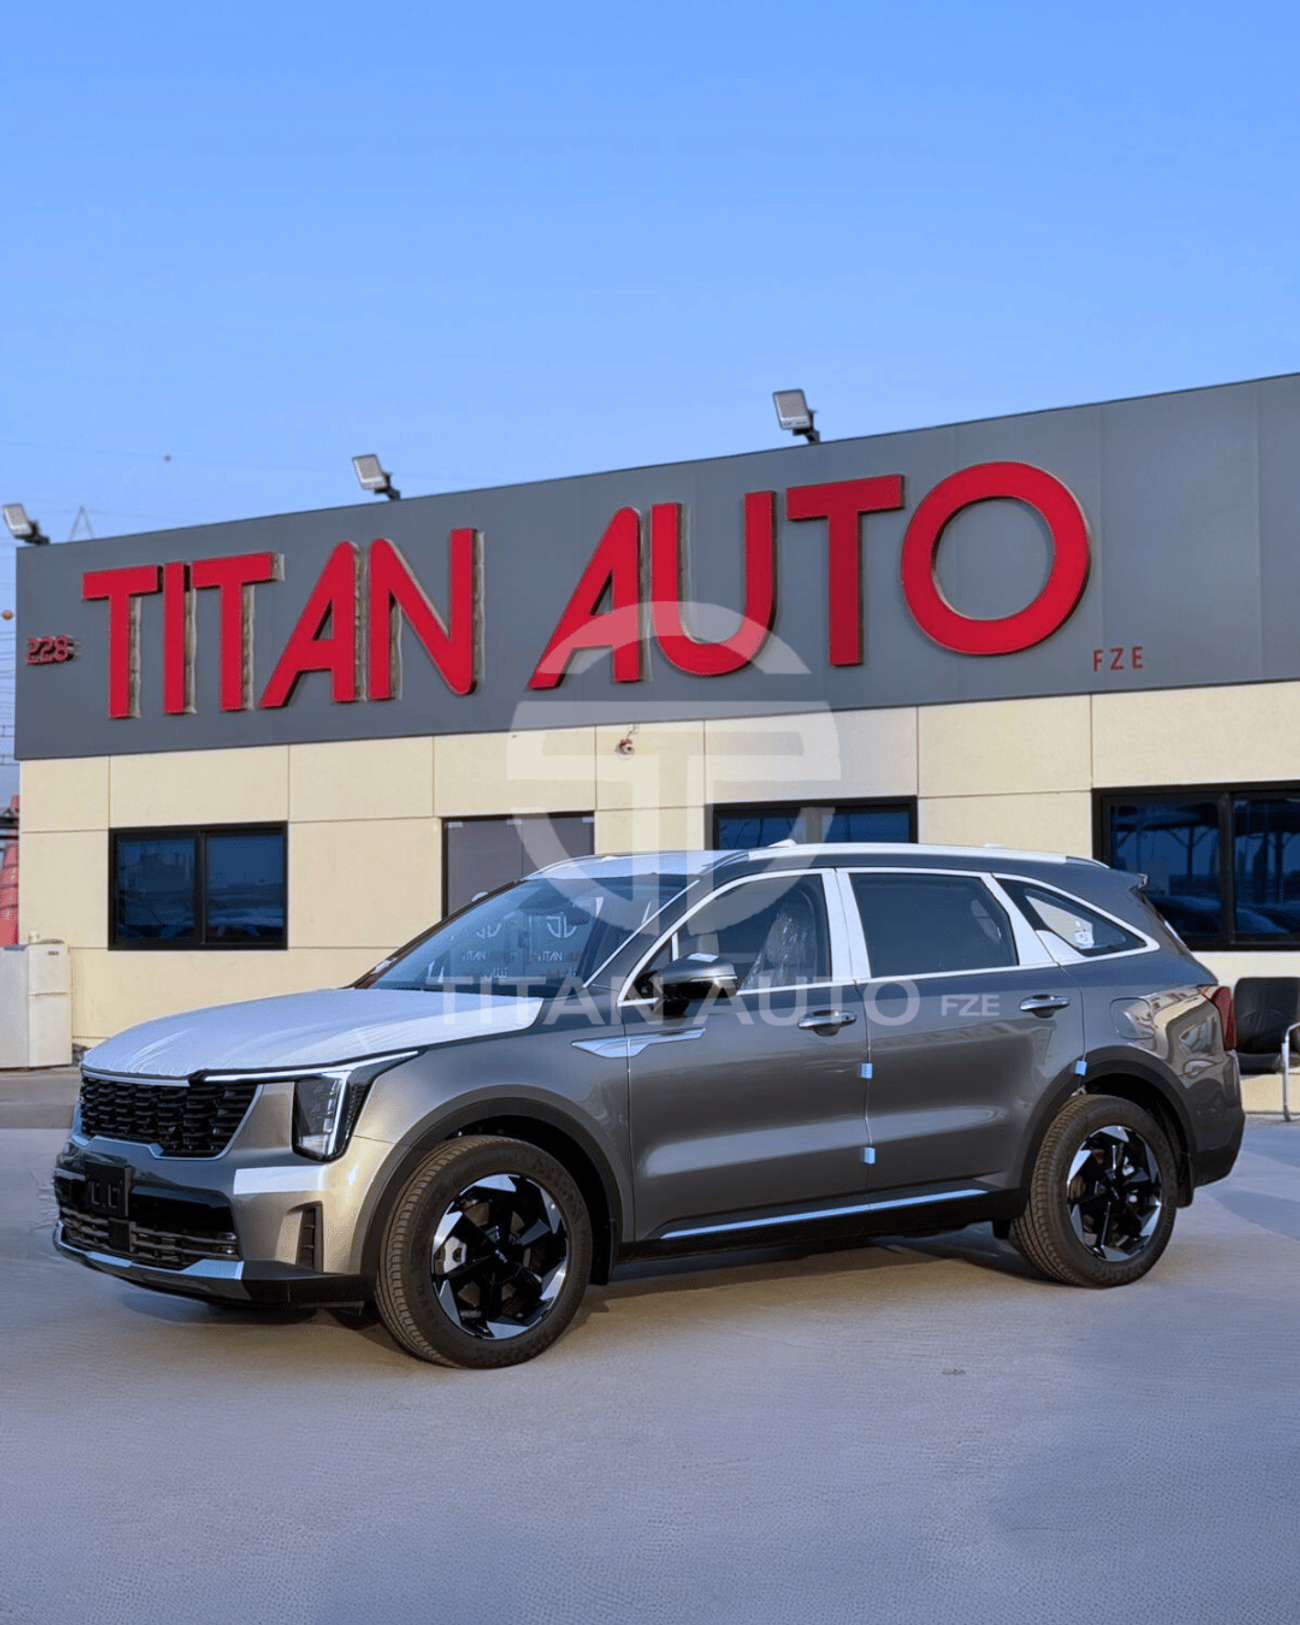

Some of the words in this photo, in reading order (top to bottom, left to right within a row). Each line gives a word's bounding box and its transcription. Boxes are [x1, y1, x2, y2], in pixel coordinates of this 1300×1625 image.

[26, 635, 73, 666] 228
[81, 528, 479, 719] TITAN
[528, 461, 1091, 690] AUTO
[1093, 646, 1143, 671] FZE
